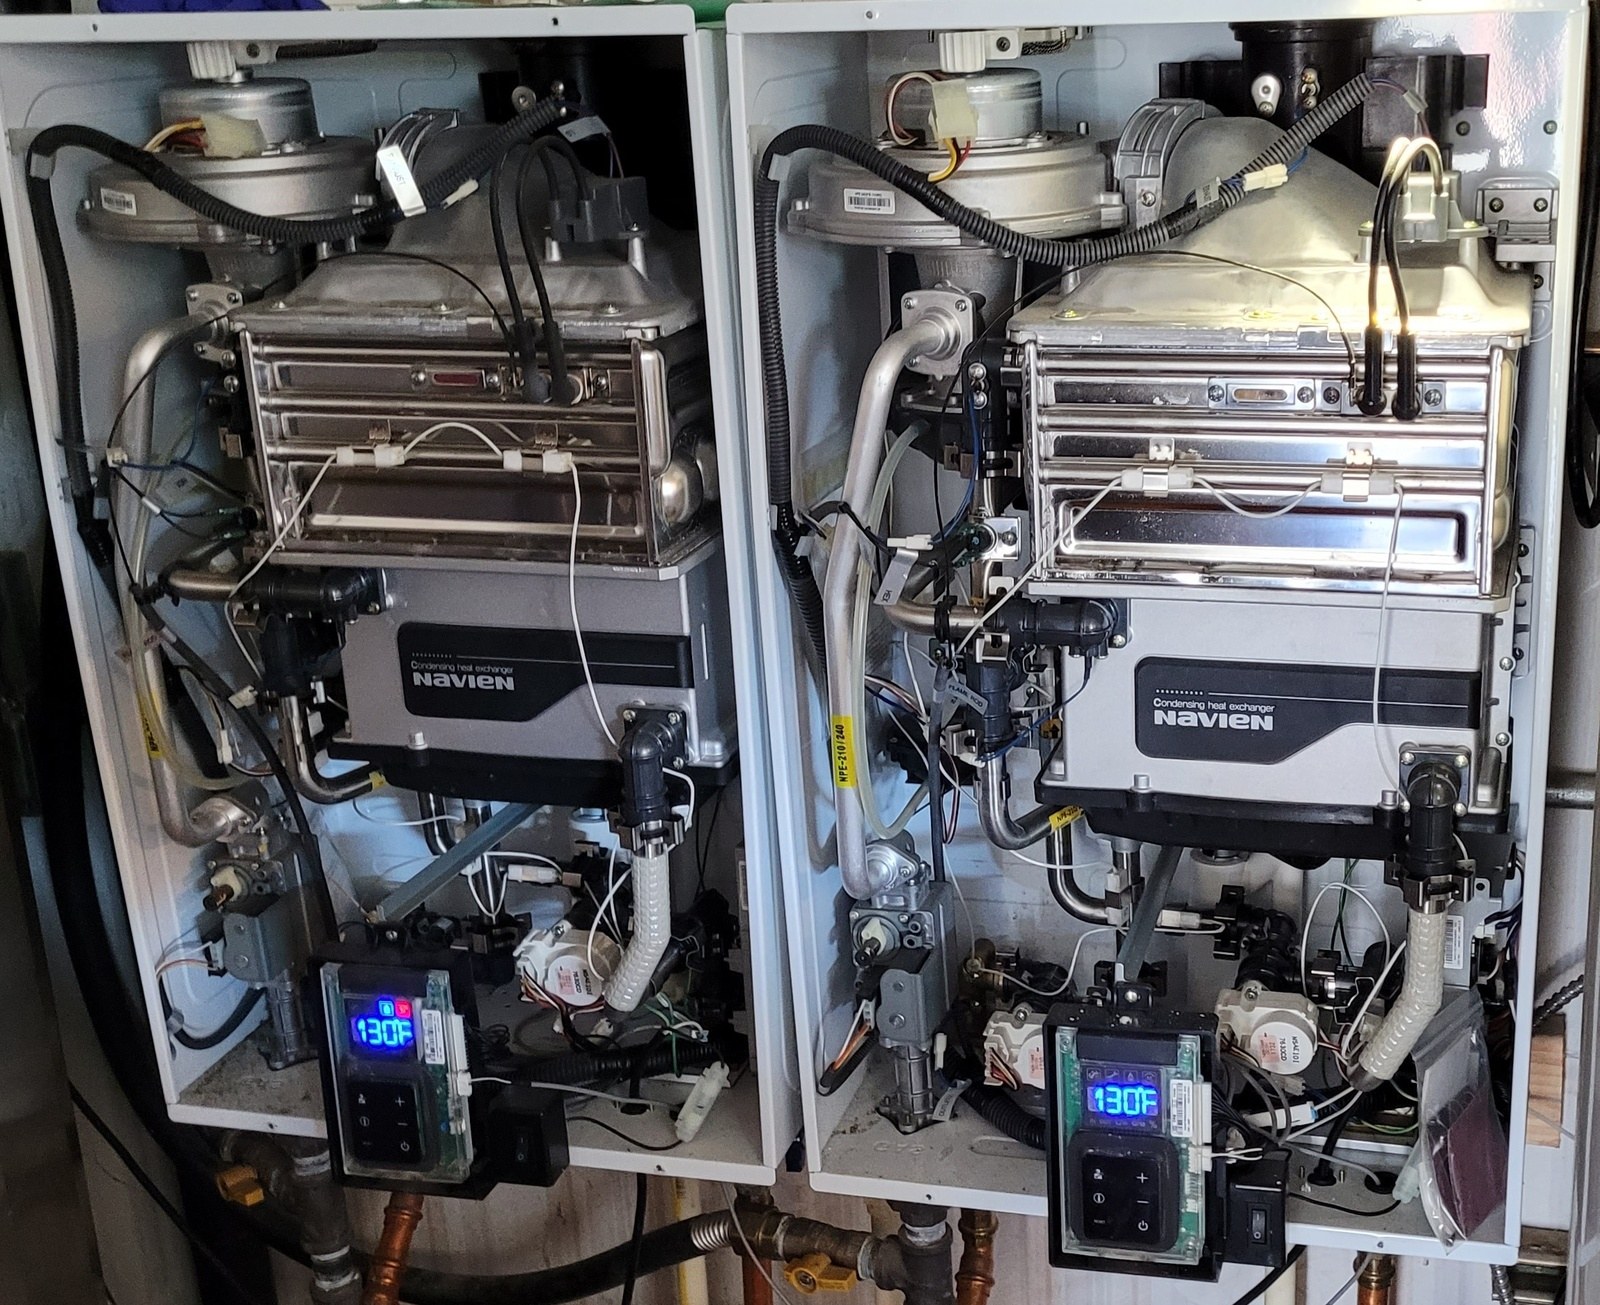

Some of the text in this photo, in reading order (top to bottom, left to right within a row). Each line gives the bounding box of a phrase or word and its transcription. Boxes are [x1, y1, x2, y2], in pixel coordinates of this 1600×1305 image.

[410, 660, 513, 675] Condensing heat exchanger
[1153, 698, 1275, 714] Condensing heat exchanger
